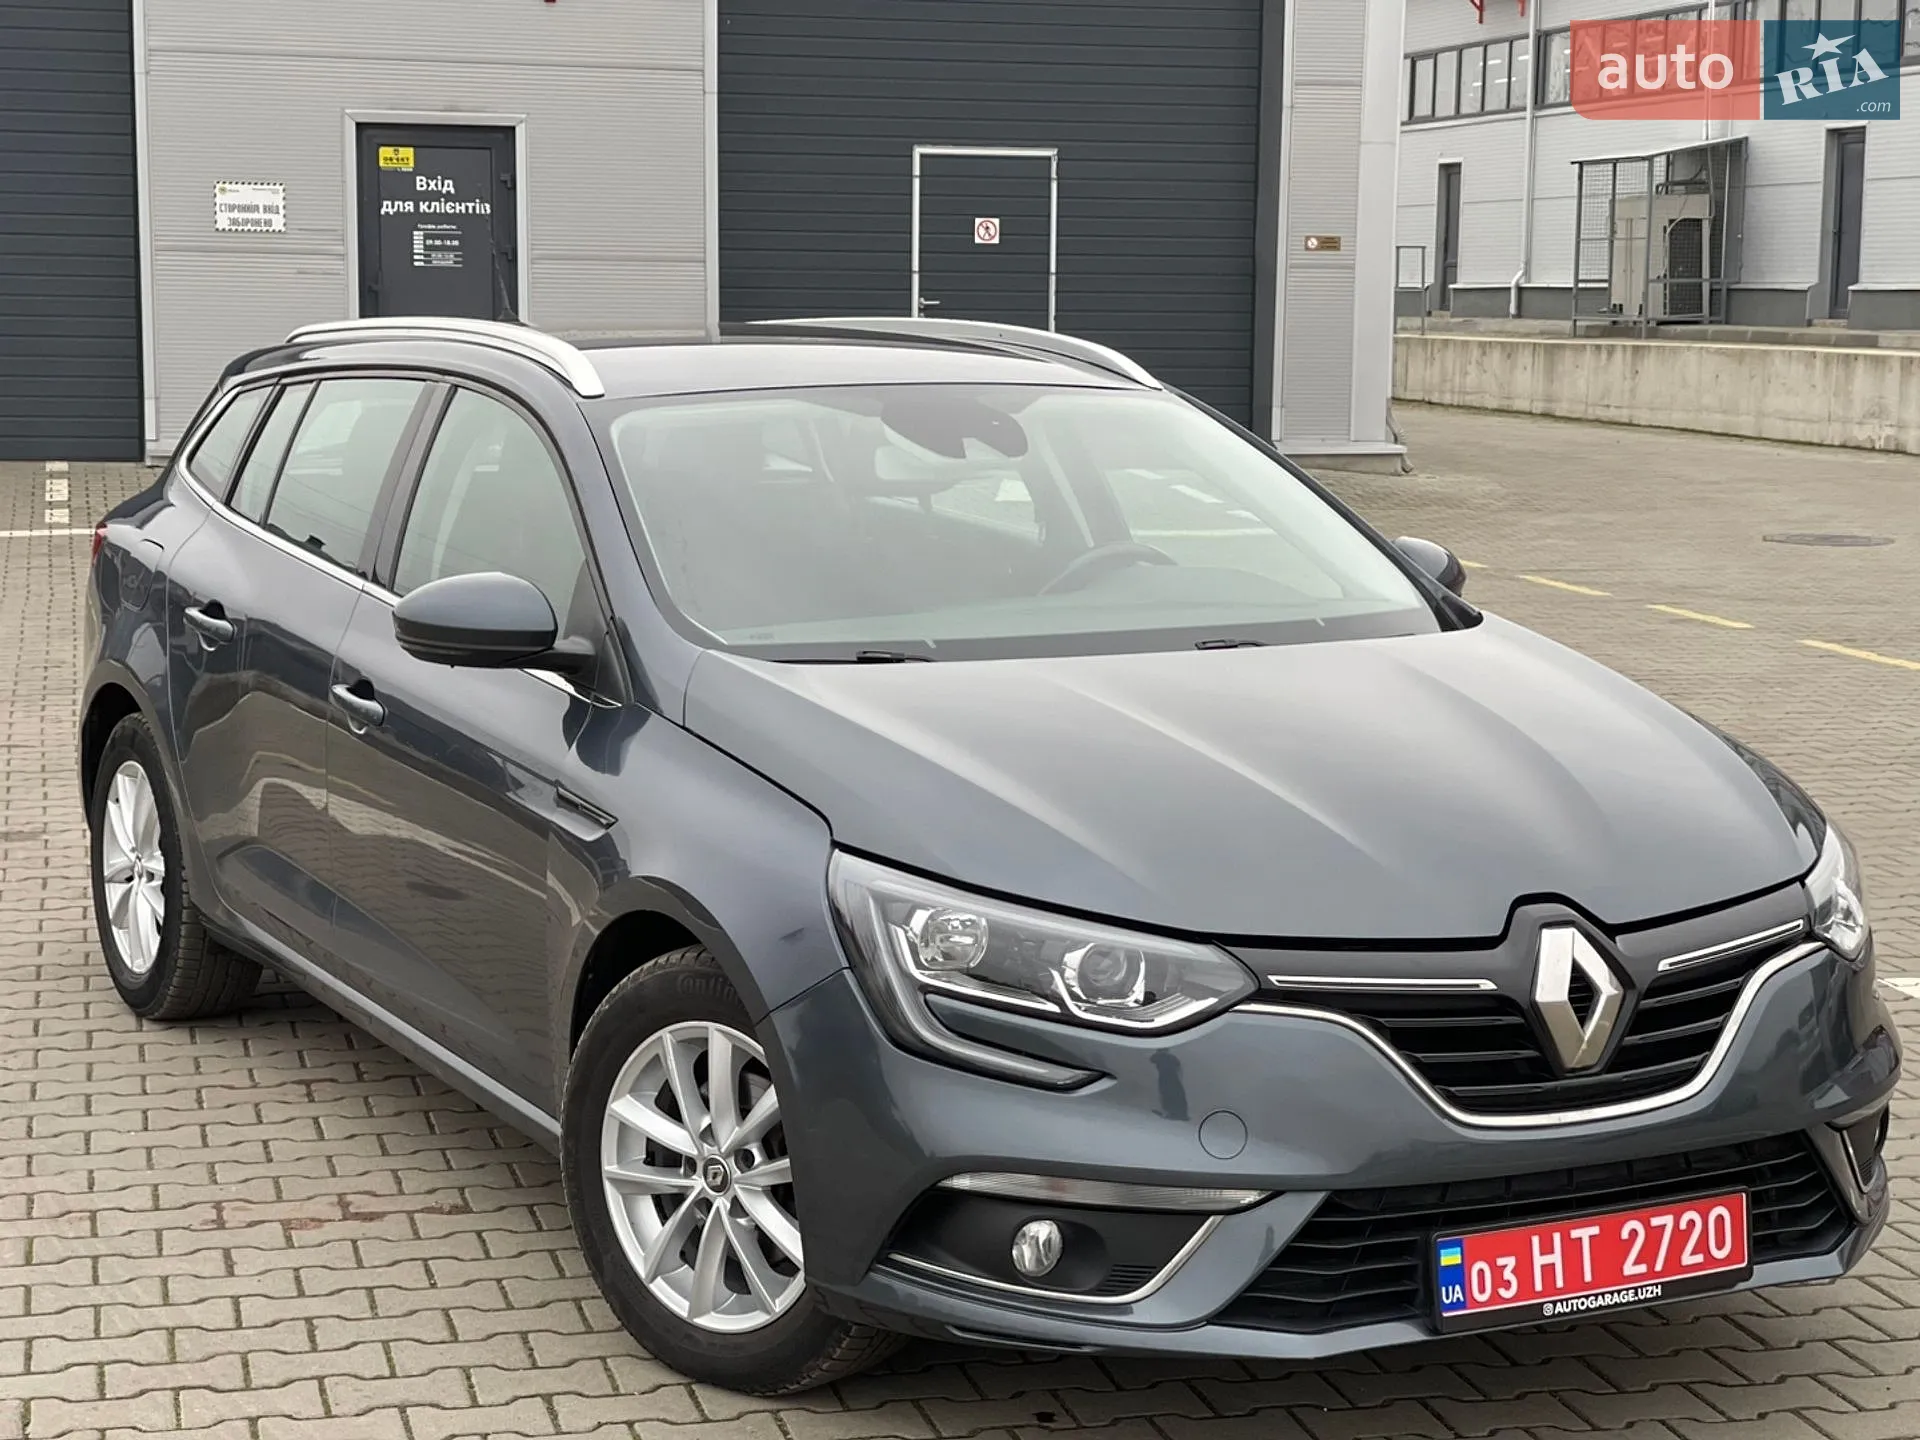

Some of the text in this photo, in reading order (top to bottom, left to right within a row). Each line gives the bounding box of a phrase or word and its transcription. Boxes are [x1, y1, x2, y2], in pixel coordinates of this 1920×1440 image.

[415, 176, 455, 194] Вхід
[381, 198, 491, 215] для клієнтів
[1471, 1205, 1732, 1303] 03 HT 2720
[1442, 1284, 1464, 1304] UA
